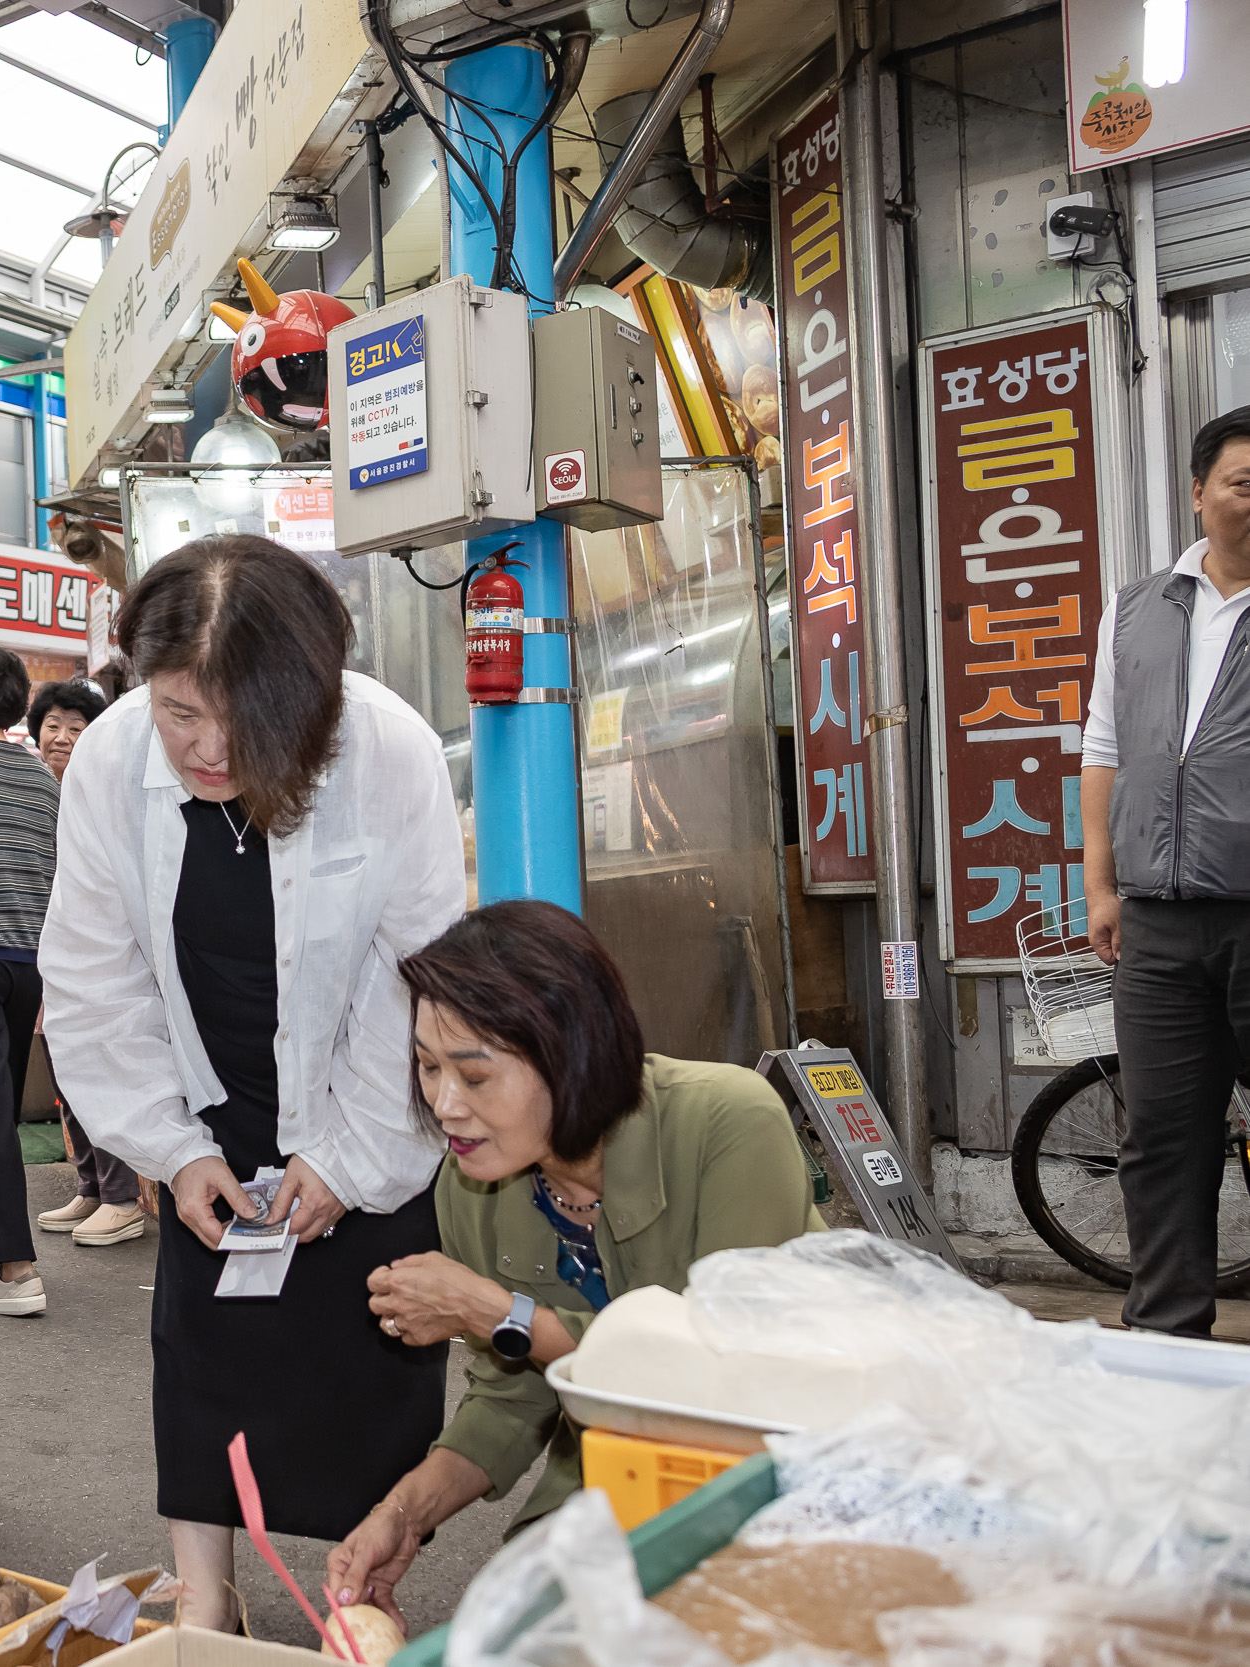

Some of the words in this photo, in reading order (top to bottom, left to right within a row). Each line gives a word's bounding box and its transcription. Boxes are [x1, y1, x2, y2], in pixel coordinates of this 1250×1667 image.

[236, 55, 257, 150] 빵
[781, 113, 841, 196] 효성당
[114, 263, 147, 354] 브레드
[349, 340, 391, 376] 경고!
[350, 401, 358, 412] 이
[360, 393, 382, 409] 지역은
[384, 379, 424, 402] 범죄예방을
[940, 347, 1087, 413] 효성당
[350, 415, 366, 428] 위해
[367, 404, 399, 422] CCTV가
[351, 427, 381, 444] 작동되고
[382, 416, 417, 434] 있습니다.
[370, 457, 416, 478] 서울광진경찰서
[553, 473, 579, 486] SEOUL
[812, 1071, 840, 1092] 최고가
[837, 1069, 861, 1091] 매입!
[835, 1102, 882, 1143] 치금
[867, 1156, 900, 1181] 금이빨
[887, 1195, 932, 1240] 14K
